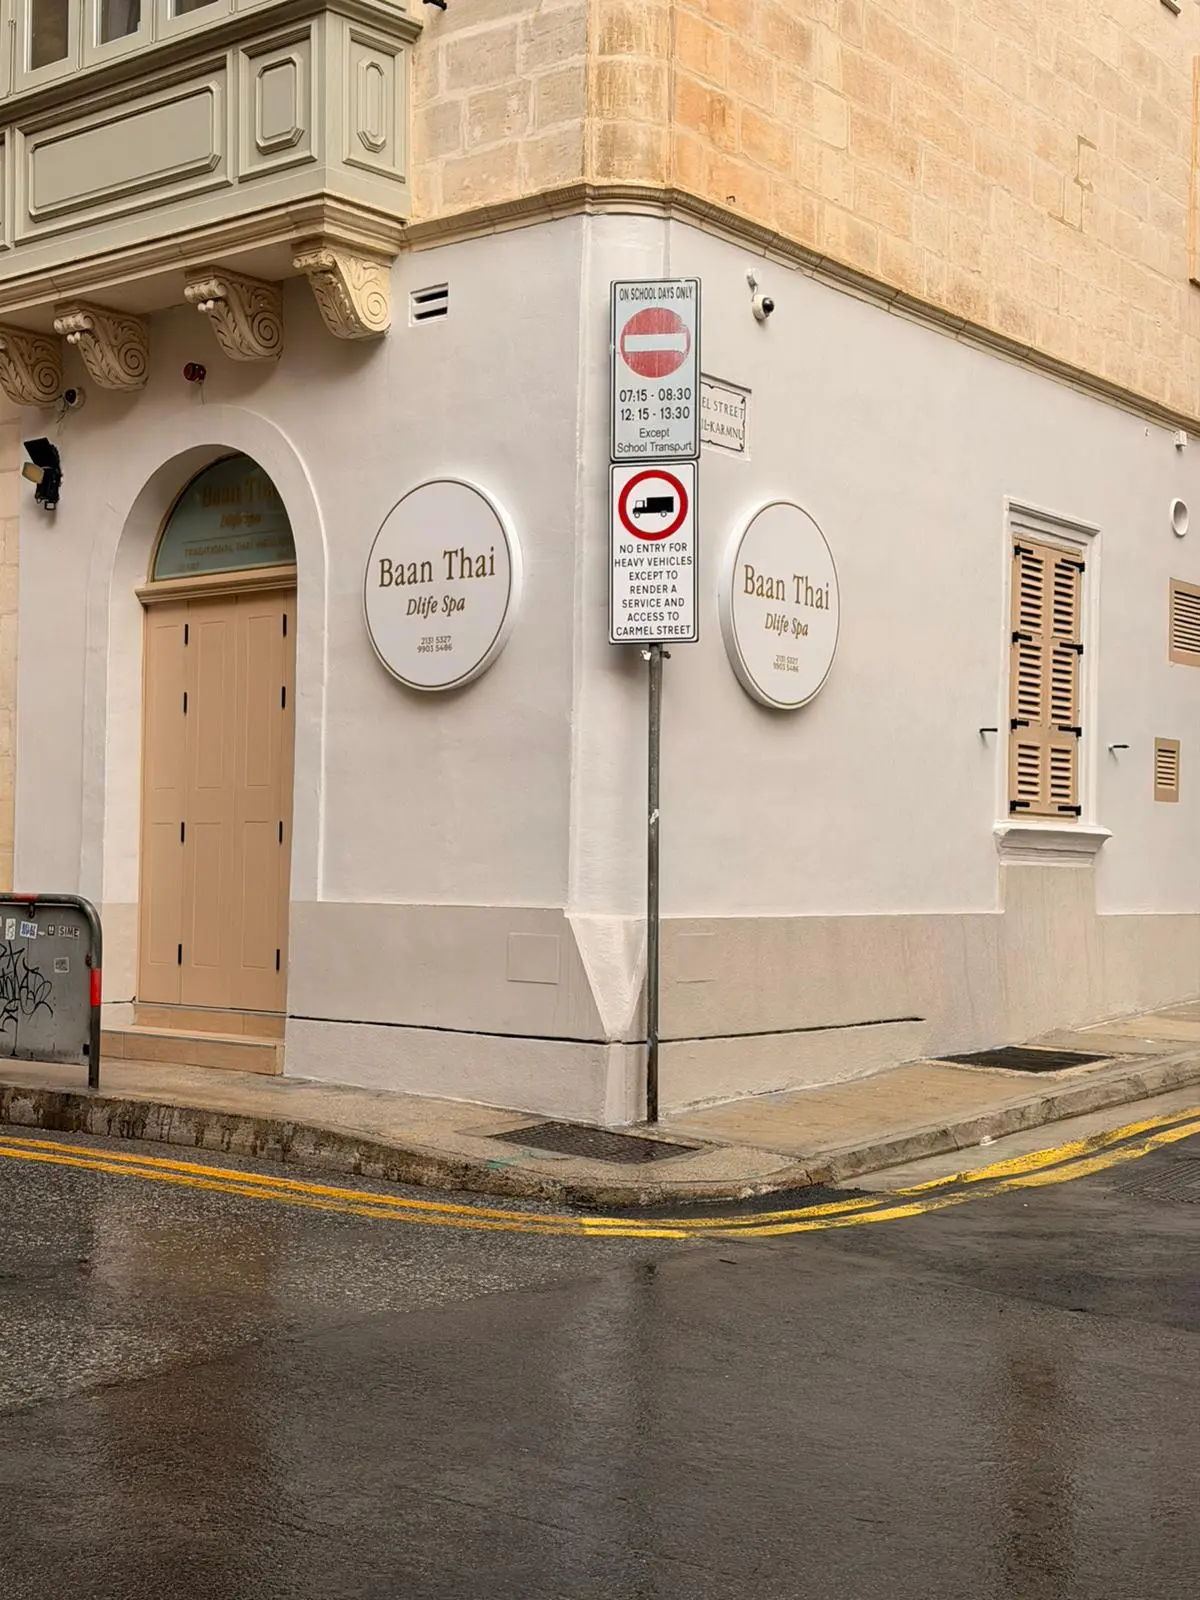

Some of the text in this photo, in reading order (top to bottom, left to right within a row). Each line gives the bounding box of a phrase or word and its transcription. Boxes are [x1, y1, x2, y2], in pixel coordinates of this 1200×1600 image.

[619, 286, 694, 301] ON SCHOOL DAYS ONLY
[620, 389, 648, 402] 07:15
[658, 388, 691, 401] 08:30
[660, 407, 690, 420] 13:30
[714, 401, 745, 419] STREET
[639, 428, 669, 439] Except
[617, 441, 692, 453] School Transport
[620, 543, 687, 554] NO ENTRY FOR
[379, 546, 496, 587] Baan Thai
[615, 556, 692, 568] HEAVY VEHICLES
[629, 571, 678, 581] EXCEPT TO
[630, 584, 677, 594] RENDER A
[744, 564, 829, 610] Baan Thai
[406, 595, 465, 619] Dlife Spa
[622, 598, 684, 608] SERVICE AND
[627, 612, 679, 622] ACCESS TO
[616, 625, 691, 636] CARMEL STREET
[765, 613, 808, 639] Dlife Spa
[417, 644, 452, 653] 9903 5486
